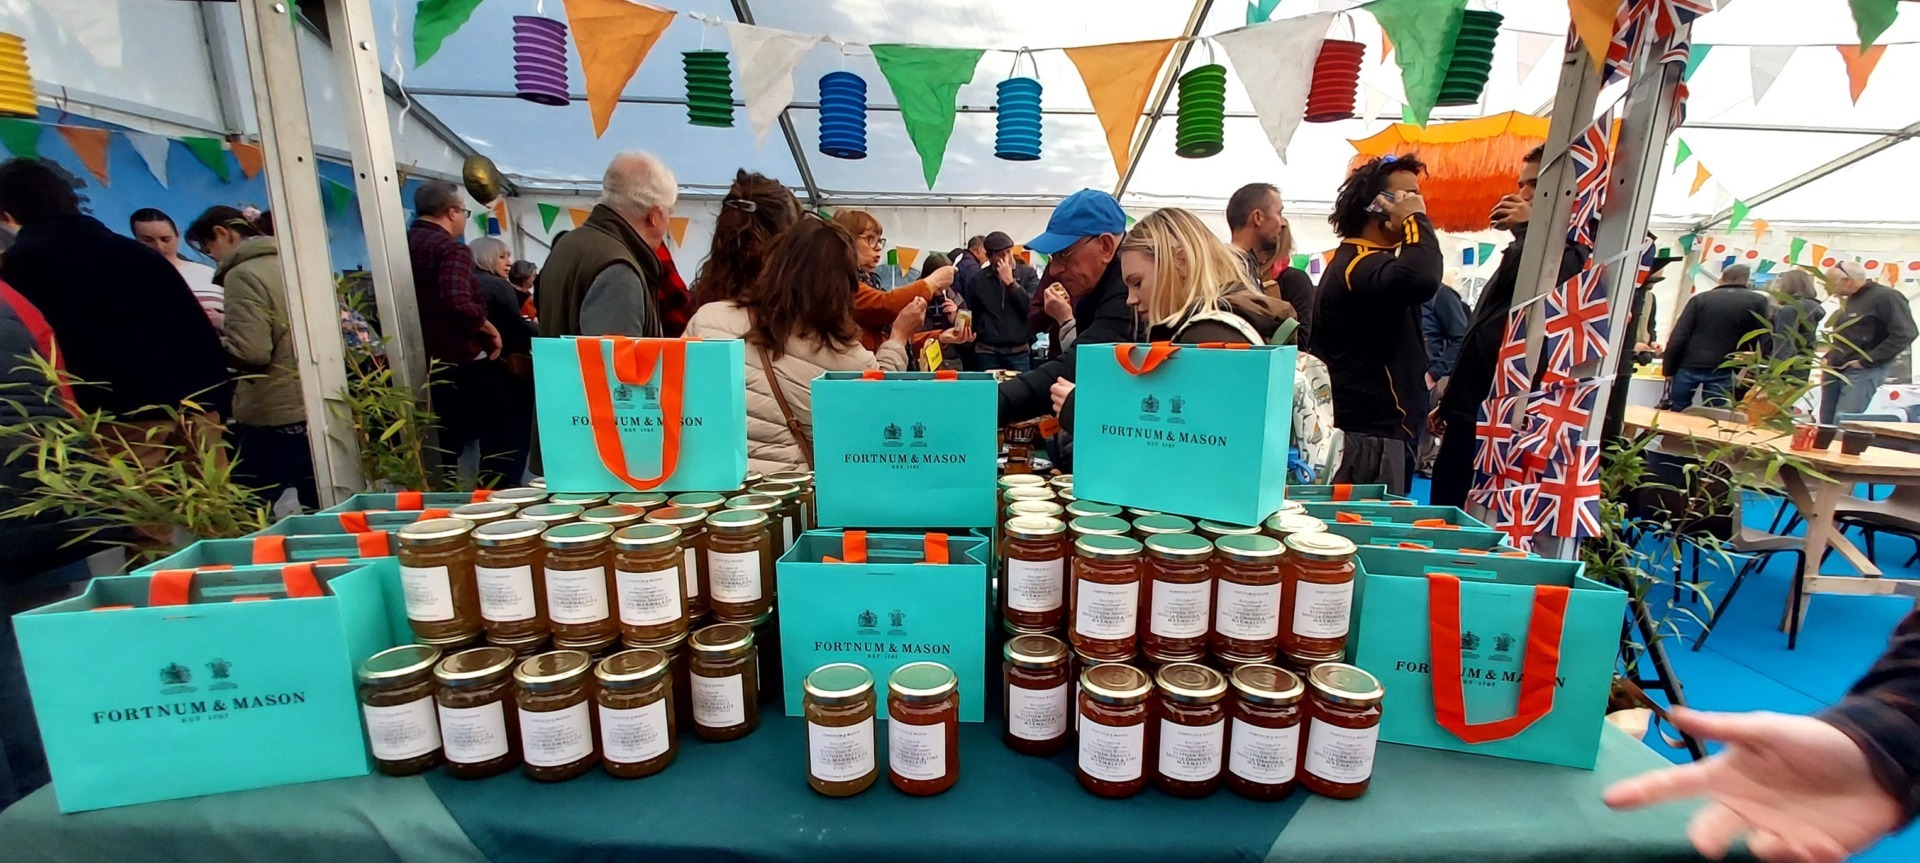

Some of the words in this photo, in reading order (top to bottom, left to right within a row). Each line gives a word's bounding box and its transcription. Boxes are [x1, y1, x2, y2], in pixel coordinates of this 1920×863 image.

[571, 416, 640, 426] FOUM
[644, 416, 654, 426] &
[656, 416, 703, 426] MSON
[1101, 424, 1163, 440] FORTNUM
[1166, 430, 1176, 442] &
[1178, 432, 1228, 446] MASON
[844, 454, 907, 464] FORTNUM
[910, 454, 920, 464] &
[922, 454, 966, 464] MASON
[815, 641, 884, 653] FORTNUM
[888, 642, 898, 653] &
[902, 643, 951, 654] MASON
[1395, 661, 1482, 678] FORM
[1485, 670, 1498, 680] &
[1501, 671, 1566, 688] MAN
[93, 700, 206, 724] FORTNUM
[213, 699, 228, 712] &
[232, 691, 308, 710] MASON
